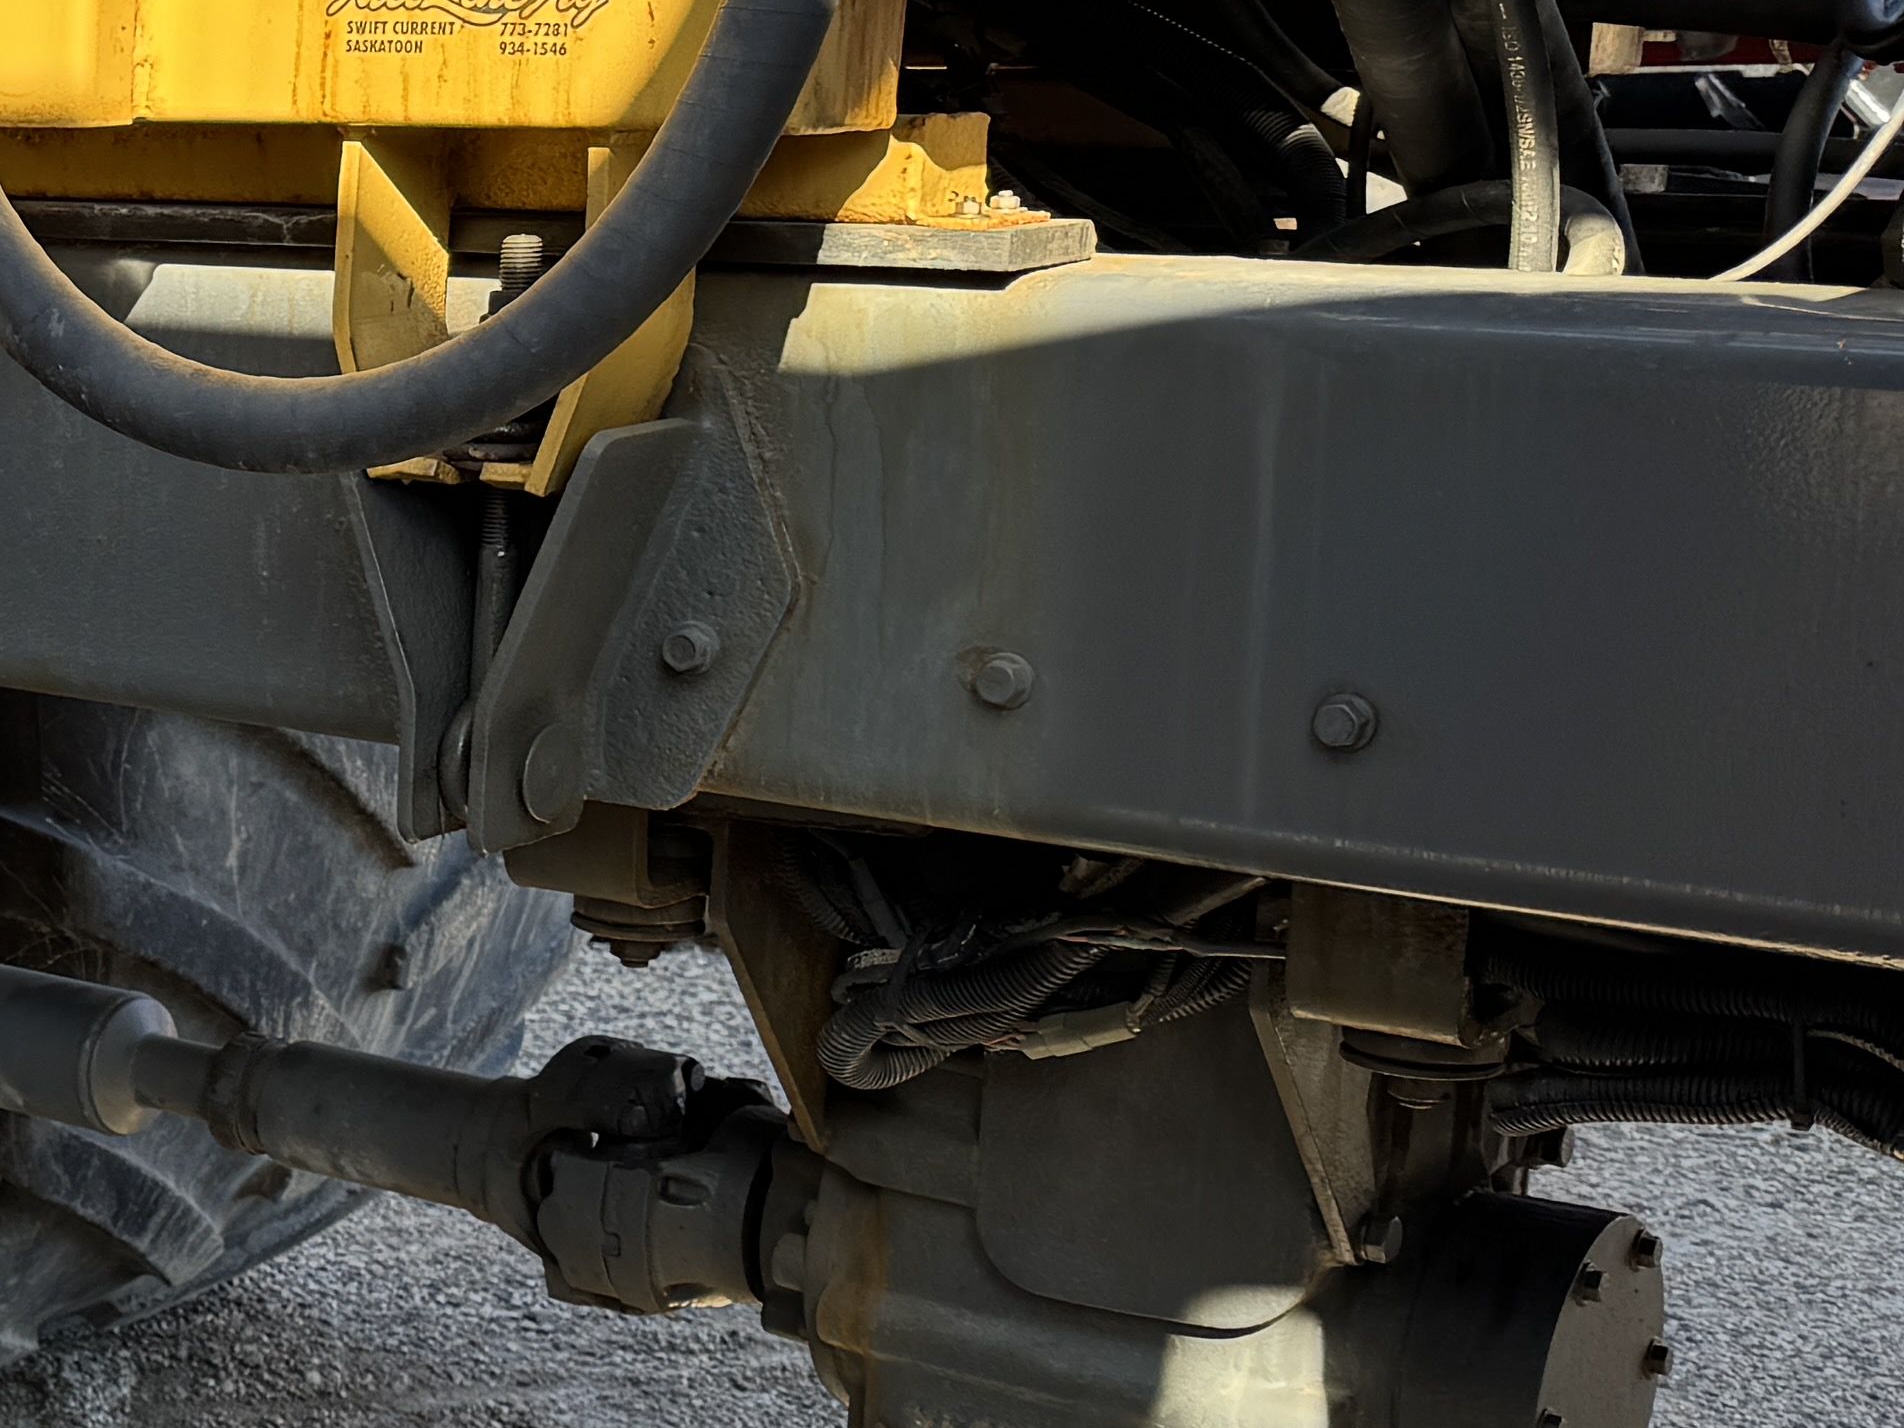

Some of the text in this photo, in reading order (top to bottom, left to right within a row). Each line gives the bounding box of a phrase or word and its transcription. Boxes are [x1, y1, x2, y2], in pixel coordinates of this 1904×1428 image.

[346, 21, 569, 38] SWIFT CURRENT 773-7281
[345, 39, 567, 56] SASKATOON 934-1546
